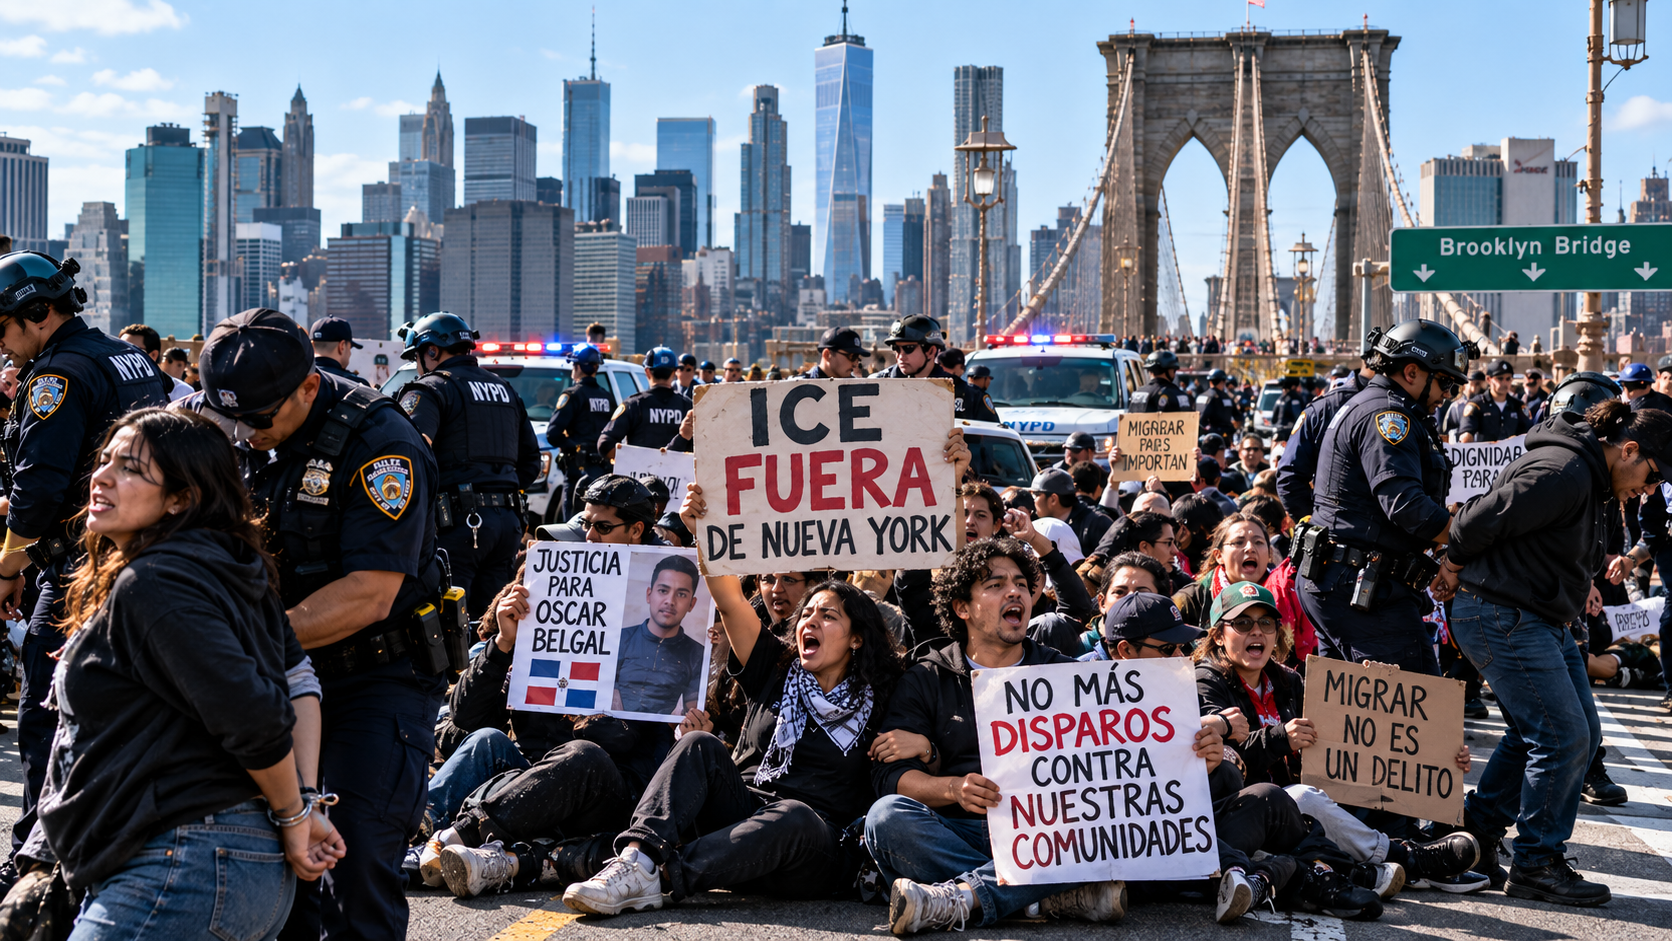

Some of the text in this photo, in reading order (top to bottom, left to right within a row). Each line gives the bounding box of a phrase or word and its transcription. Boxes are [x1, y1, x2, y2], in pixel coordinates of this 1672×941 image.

[1440, 235, 1631, 260] Brooklyn Bridge
[108, 353, 155, 381] NYPD
[468, 381, 510, 403] NYPD
[649, 408, 682, 425] NYPD
[750, 383, 882, 447] ICE
[725, 447, 938, 516] FUERA
[707, 514, 954, 561] DE NUEVA YORK
[533, 549, 622, 576] JUSTICIA
[548, 576, 594, 598] PARA
[535, 600, 607, 627] OSCAR
[532, 628, 611, 655] BELGAL
[1004, 662, 1144, 714] NO MÁS
[1324, 670, 1428, 721] MIGRAR
[990, 705, 1175, 756] DISPAROS
[1343, 714, 1419, 756] NO ES
[1031, 747, 1156, 787] CONTRA
[1325, 748, 1453, 799] UN DELITO
[1010, 780, 1184, 829] NUESTRAS
[1012, 815, 1212, 870] COMUNIDADES
